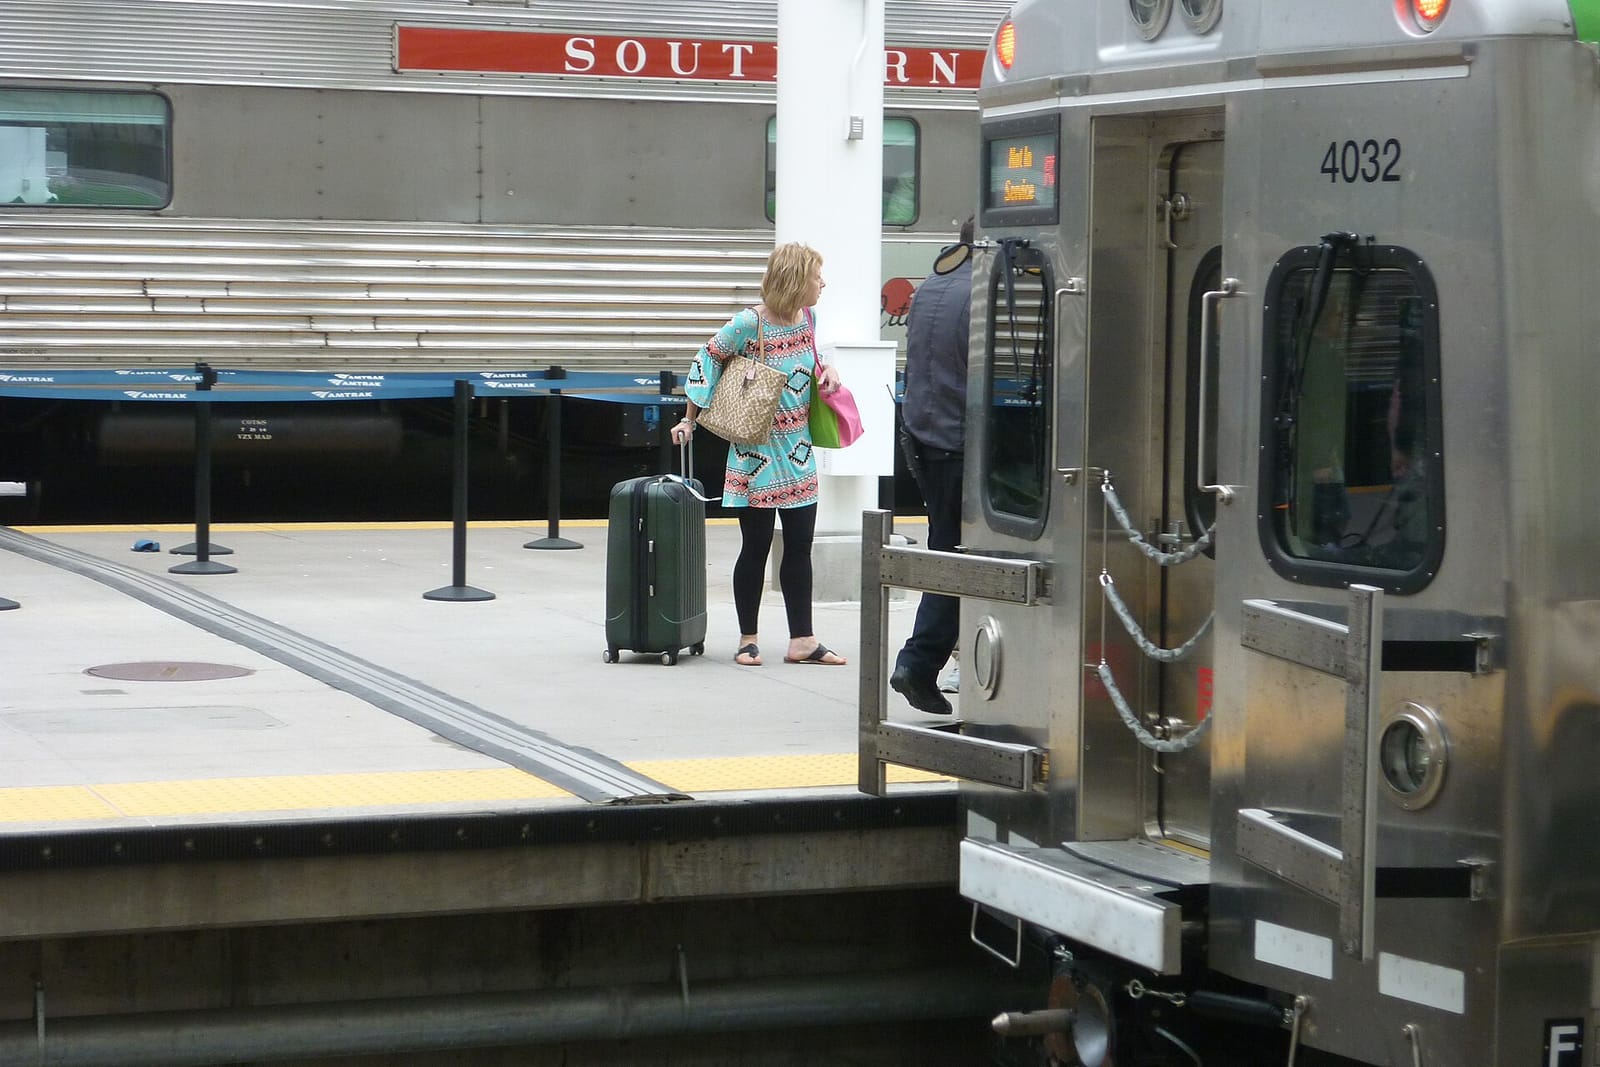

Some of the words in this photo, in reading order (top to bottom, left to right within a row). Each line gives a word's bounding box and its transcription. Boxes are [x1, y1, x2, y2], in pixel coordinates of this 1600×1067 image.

[565, 37, 960, 85] SOUTRN
[1321, 138, 1401, 183] 4032
[1004, 179, 1035, 201] Service
[1549, 1025, 1578, 1067] F
